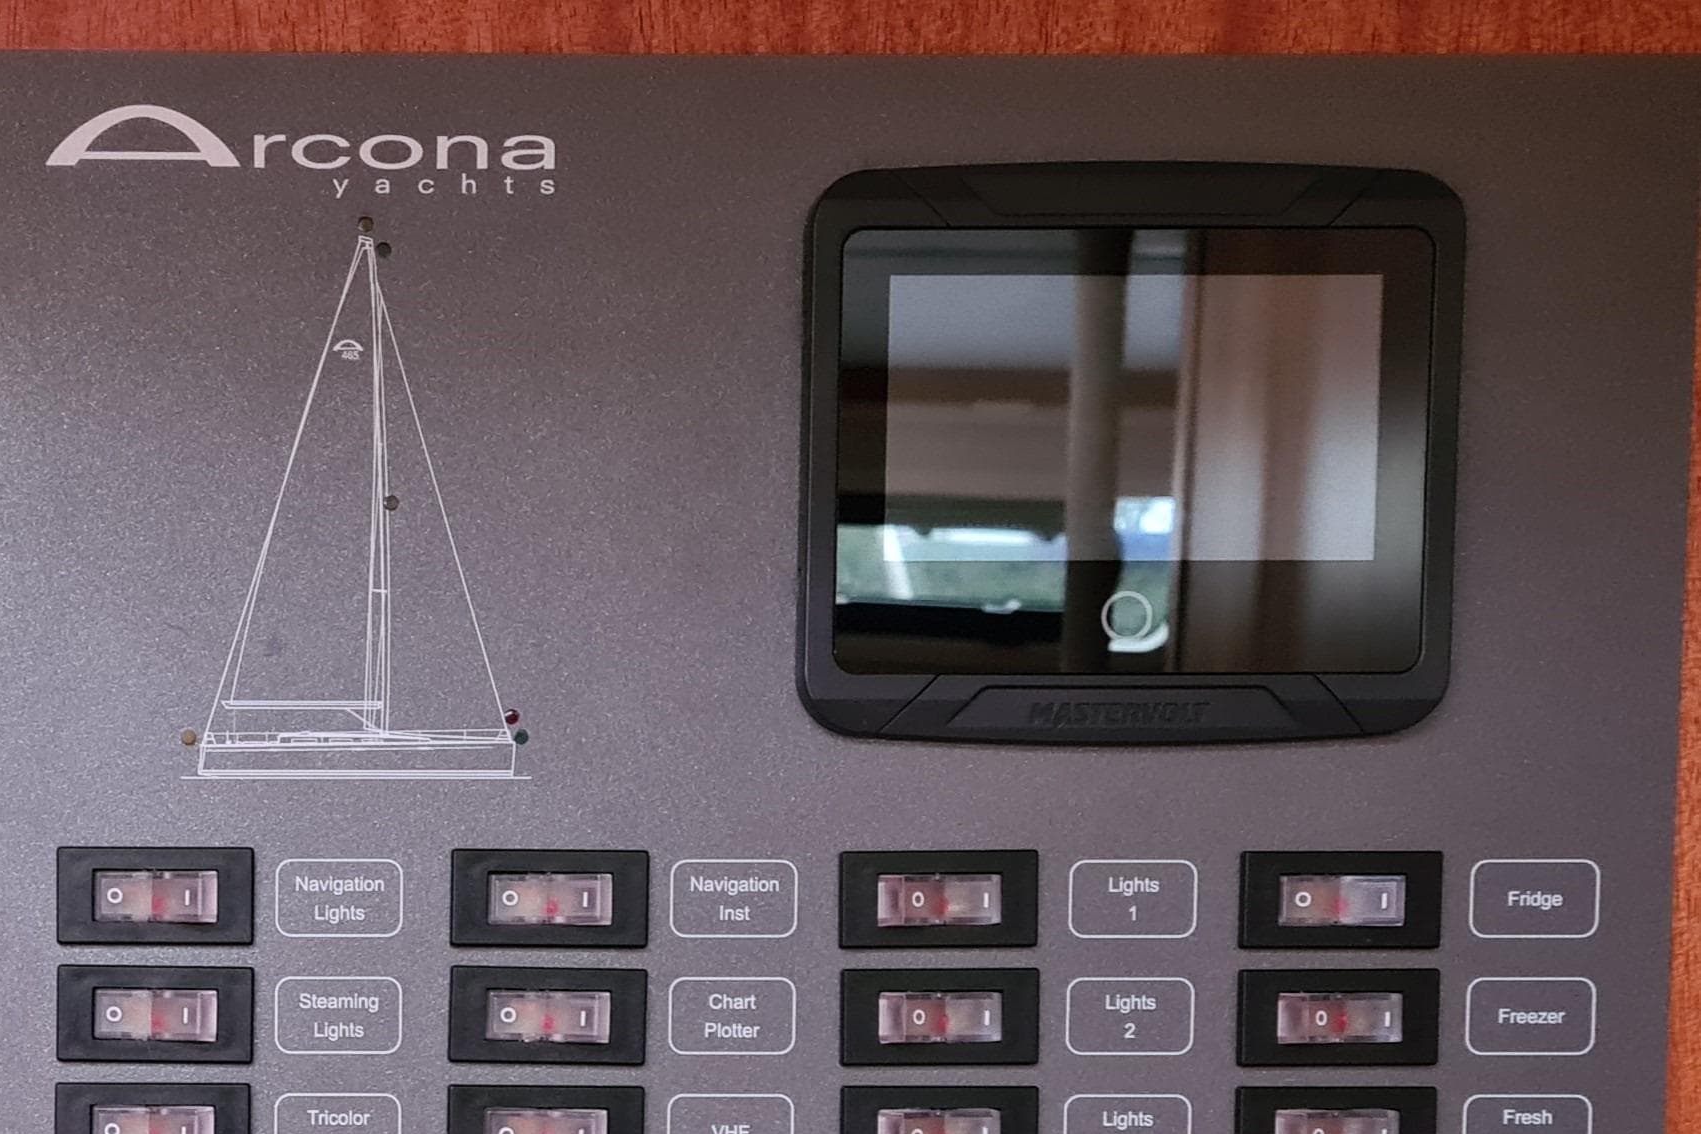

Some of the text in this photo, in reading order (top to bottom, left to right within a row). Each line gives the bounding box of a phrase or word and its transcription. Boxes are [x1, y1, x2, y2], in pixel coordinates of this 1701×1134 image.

[45, 104, 556, 170] Arcona
[333, 174, 555, 198] yachts
[295, 876, 384, 894] Navigation
[690, 877, 779, 894] Navigation
[1108, 877, 1159, 894] Lights
[1508, 891, 1563, 909] Fridge
[315, 905, 365, 922] Lights
[719, 905, 750, 920] Inst
[1129, 906, 1137, 920] 1
[299, 993, 379, 1013] Steaming
[709, 994, 756, 1010] Chart
[1105, 994, 1156, 1011] Lights
[1498, 1008, 1565, 1024] Freezer
[314, 1023, 364, 1040] Lights
[704, 1022, 759, 1038] Plotter
[1124, 1023, 1135, 1038] 2
[307, 1110, 370, 1126] Tricolor
[1103, 1111, 1154, 1128] Lights
[1503, 1110, 1553, 1125] Fresh
